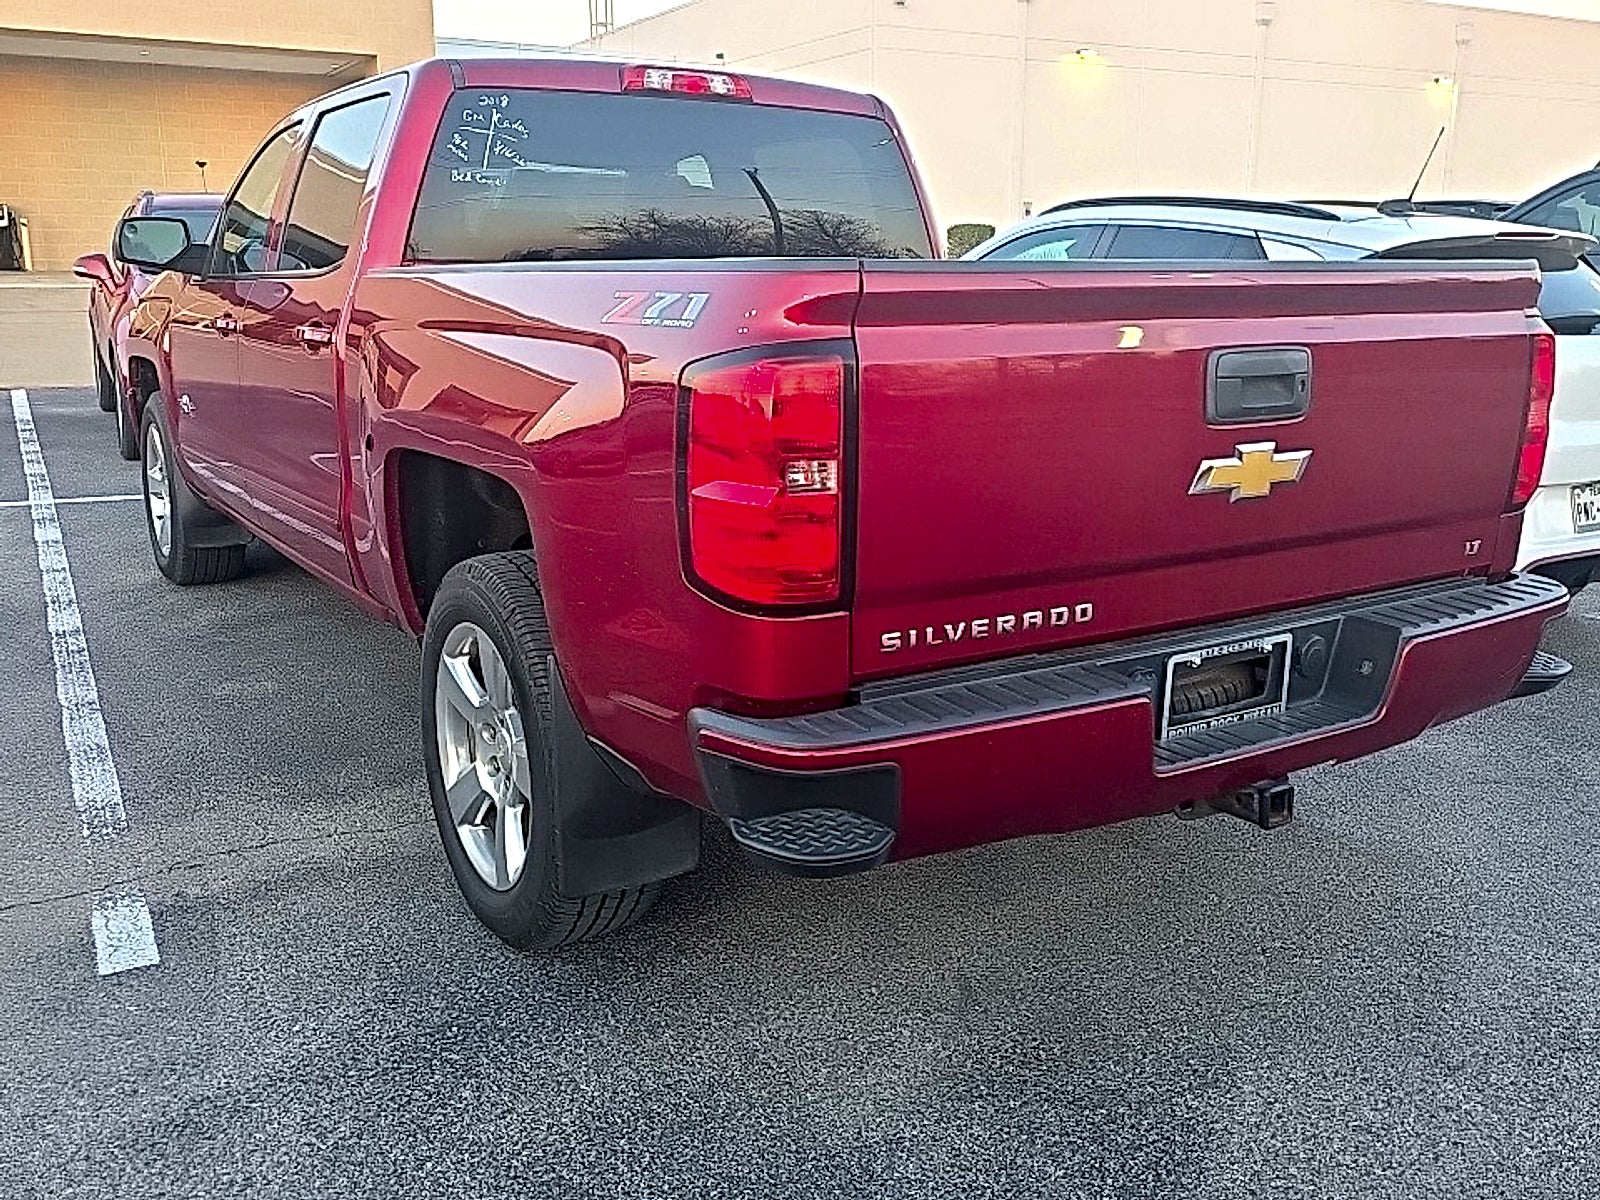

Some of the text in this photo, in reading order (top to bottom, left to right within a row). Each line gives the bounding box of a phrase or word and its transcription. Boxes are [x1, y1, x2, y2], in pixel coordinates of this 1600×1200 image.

[478, 94, 510, 107] 2018
[601, 290, 710, 325] Z71
[1464, 540, 1482, 555] LT
[880, 602, 1094, 652] SILVERADO
